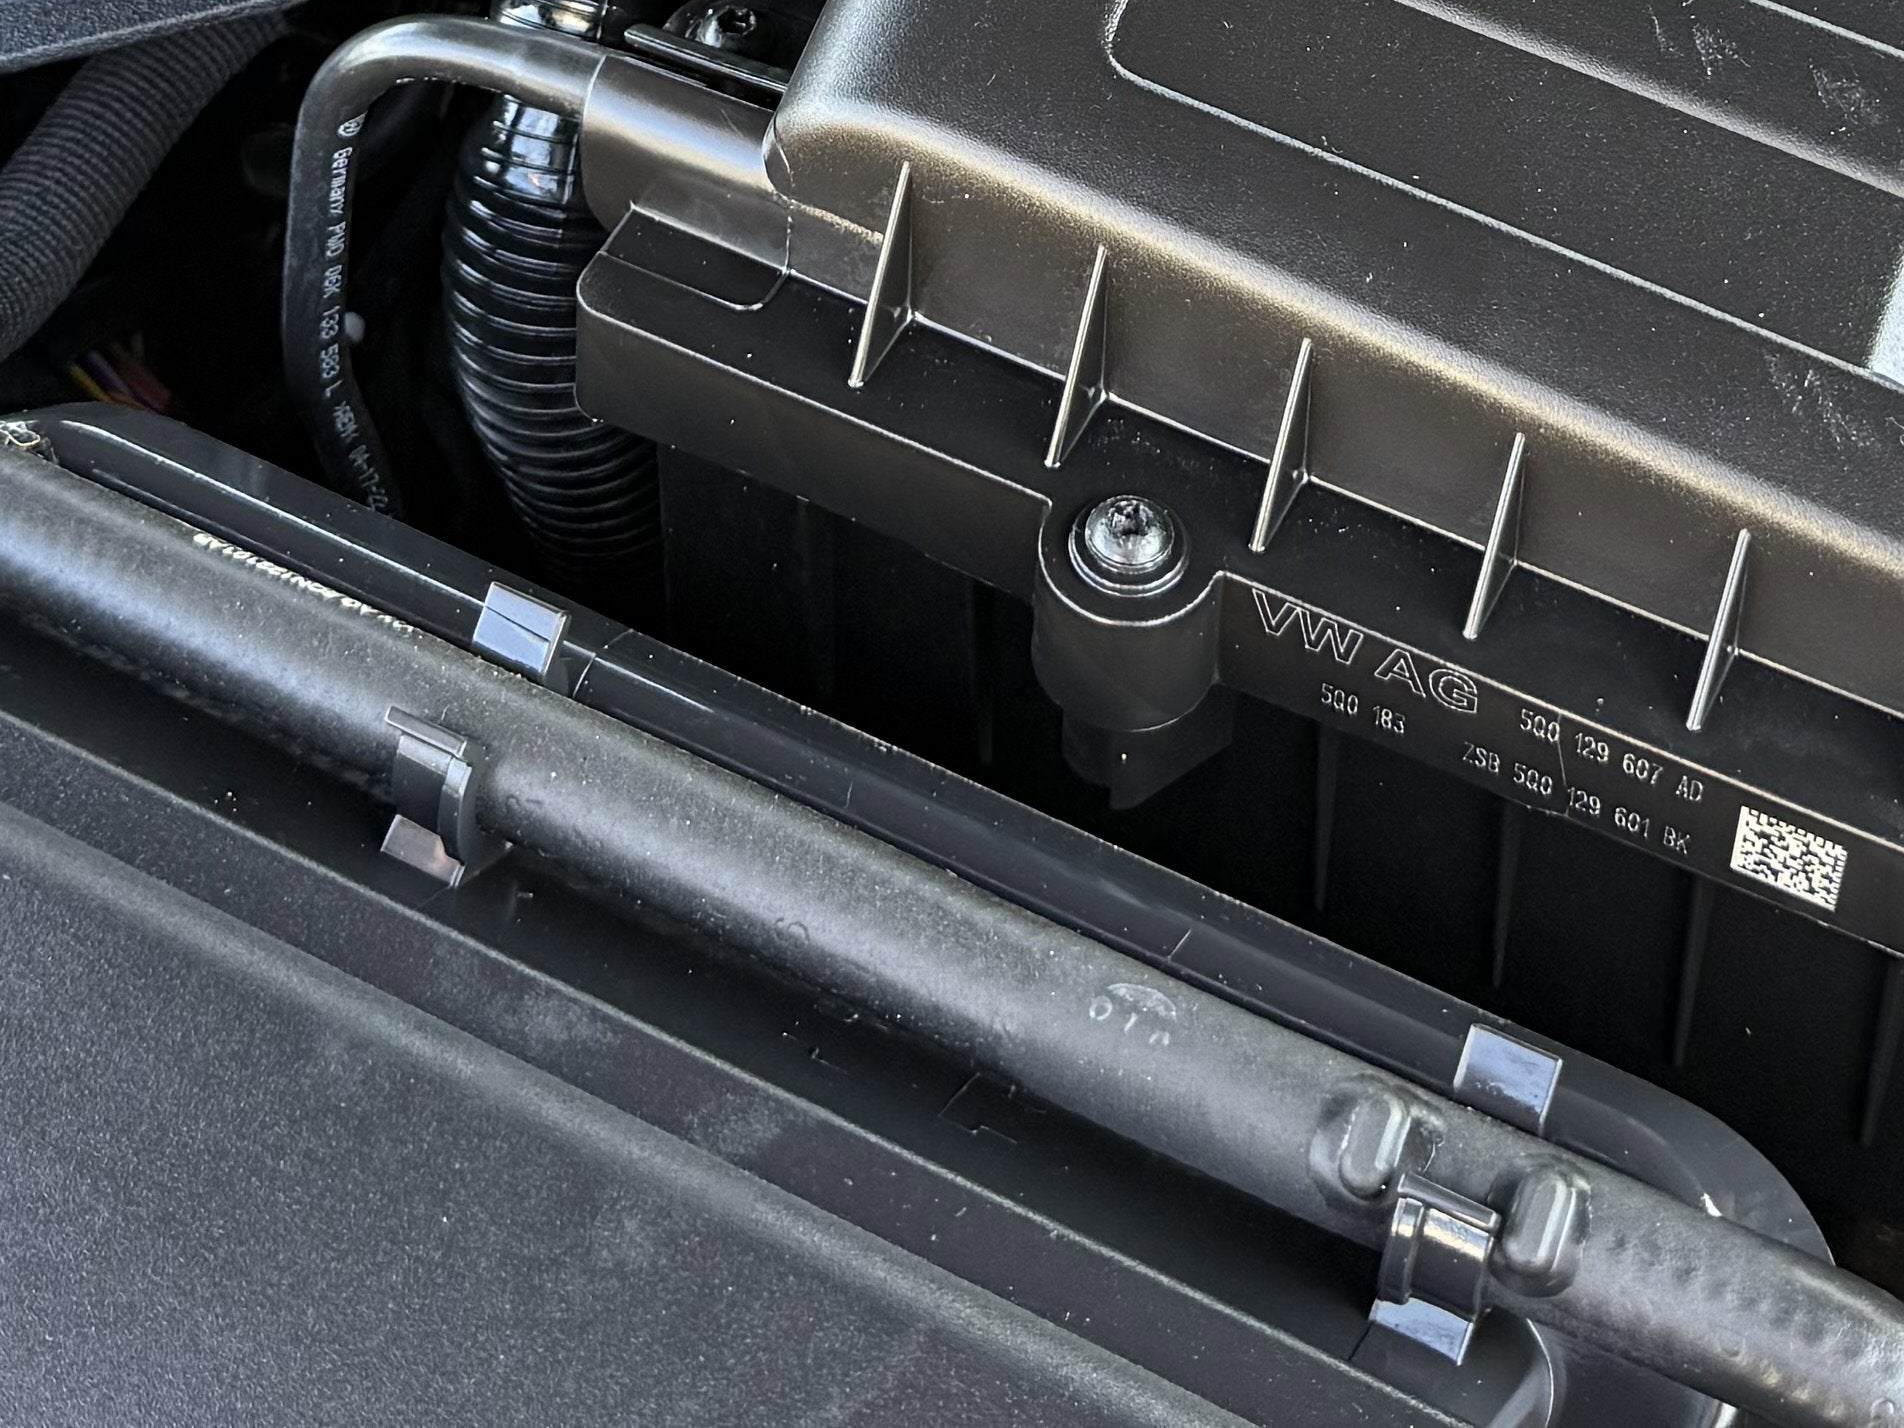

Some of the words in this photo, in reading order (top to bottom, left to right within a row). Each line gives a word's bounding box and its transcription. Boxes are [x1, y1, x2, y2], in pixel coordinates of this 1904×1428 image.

[320, 306, 341, 340] 133
[321, 343, 340, 379] 583
[325, 380, 343, 398] L
[1252, 588, 1364, 665] VW
[1374, 649, 1479, 714] AG
[1372, 704, 1407, 734] 183
[1574, 732, 1609, 763] 129
[1622, 750, 1664, 784] 607
[1676, 776, 1705, 804] AD
[1462, 741, 1500, 775] ZSB
[1567, 786, 1602, 817] 129
[1614, 805, 1650, 840] 601
[1663, 825, 1692, 856] BK
